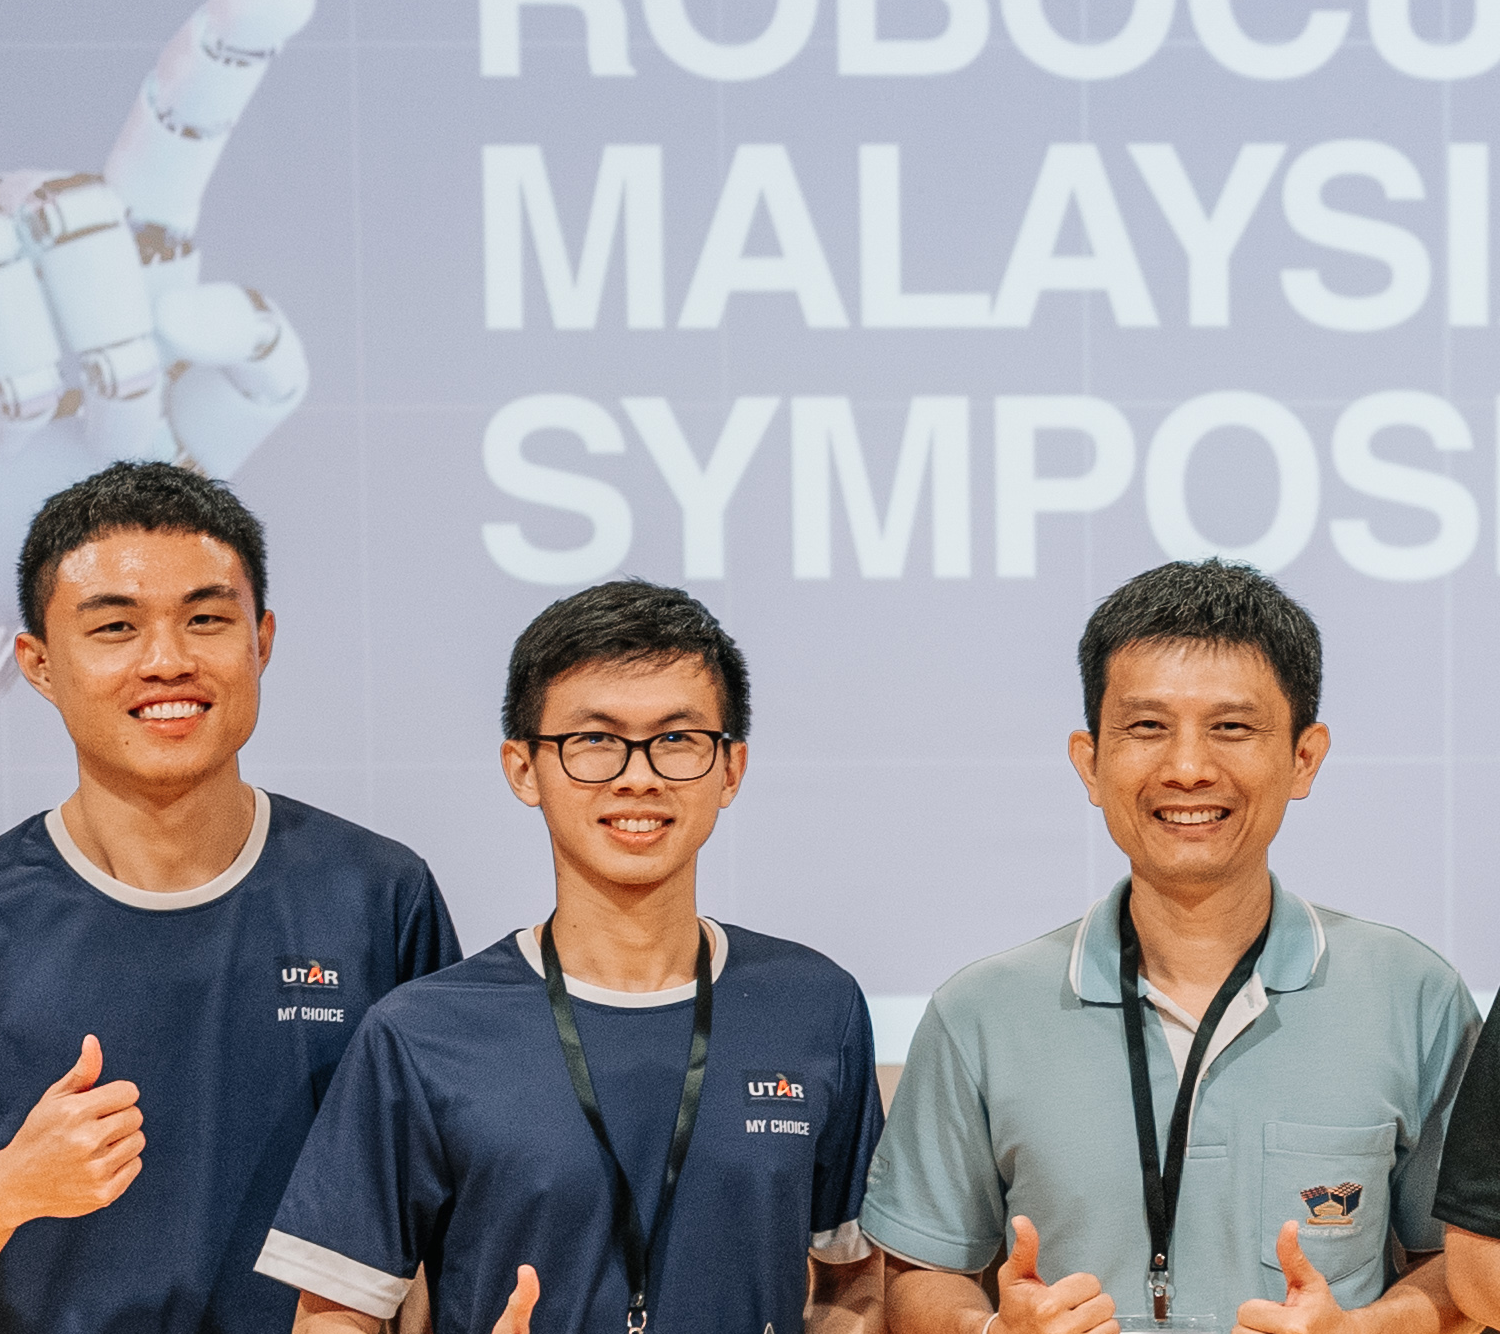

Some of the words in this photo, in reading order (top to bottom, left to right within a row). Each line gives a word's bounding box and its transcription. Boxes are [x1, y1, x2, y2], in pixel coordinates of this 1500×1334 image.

[282, 965, 339, 985] UTAR
[277, 1006, 298, 1022] MY
[301, 1006, 345, 1023] CHOICE
[748, 1078, 805, 1099] UTAR
[745, 1119, 767, 1134] MY
[770, 1119, 810, 1136] CHOICE
